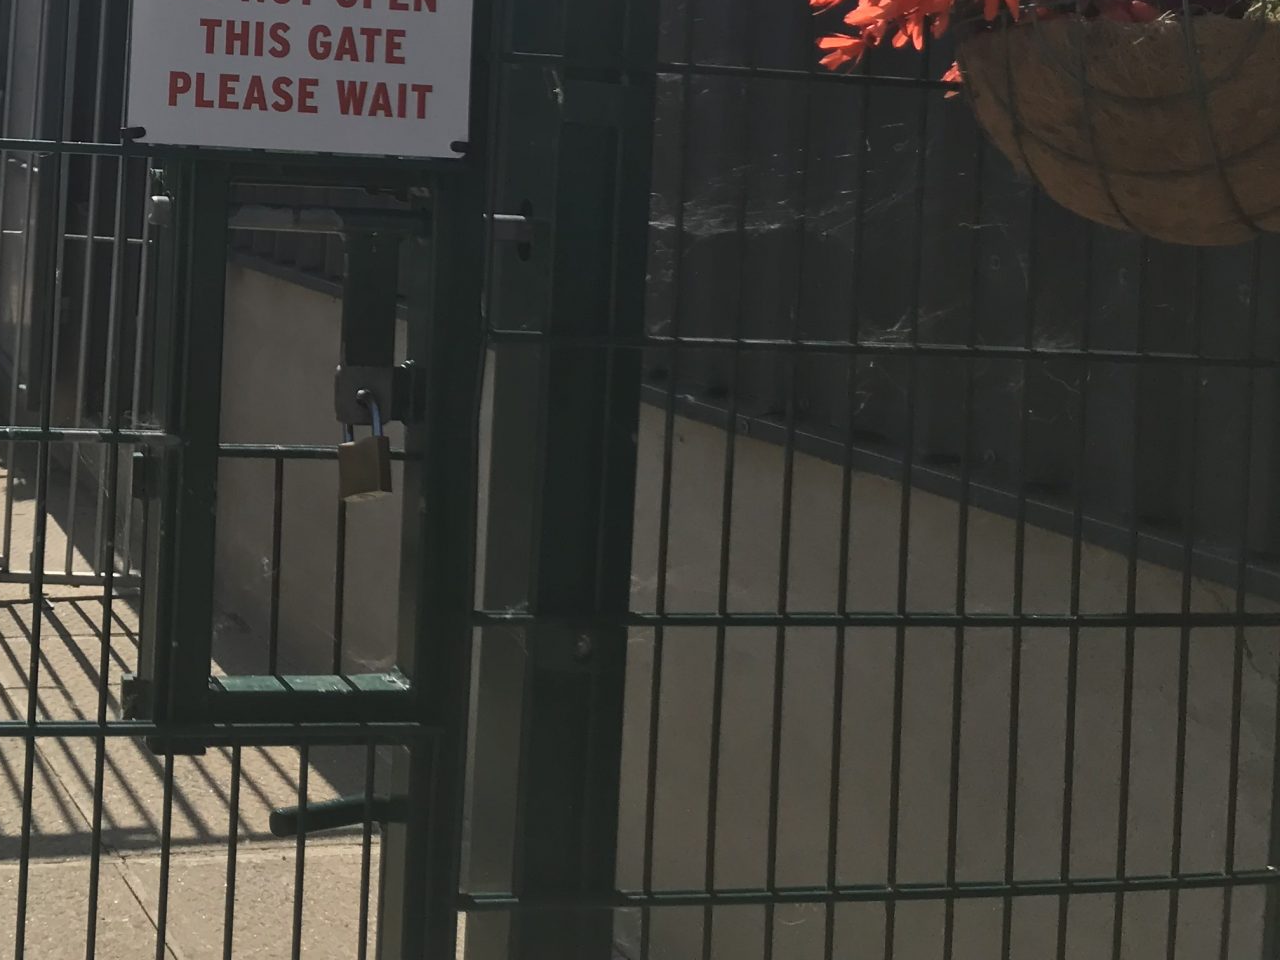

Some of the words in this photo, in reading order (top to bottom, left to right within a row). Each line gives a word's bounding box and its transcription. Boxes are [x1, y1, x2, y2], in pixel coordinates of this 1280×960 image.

[199, 18, 291, 58] THIS
[308, 24, 407, 65] GATE
[168, 70, 320, 114] PLEASE
[336, 79, 433, 120] WAIT
